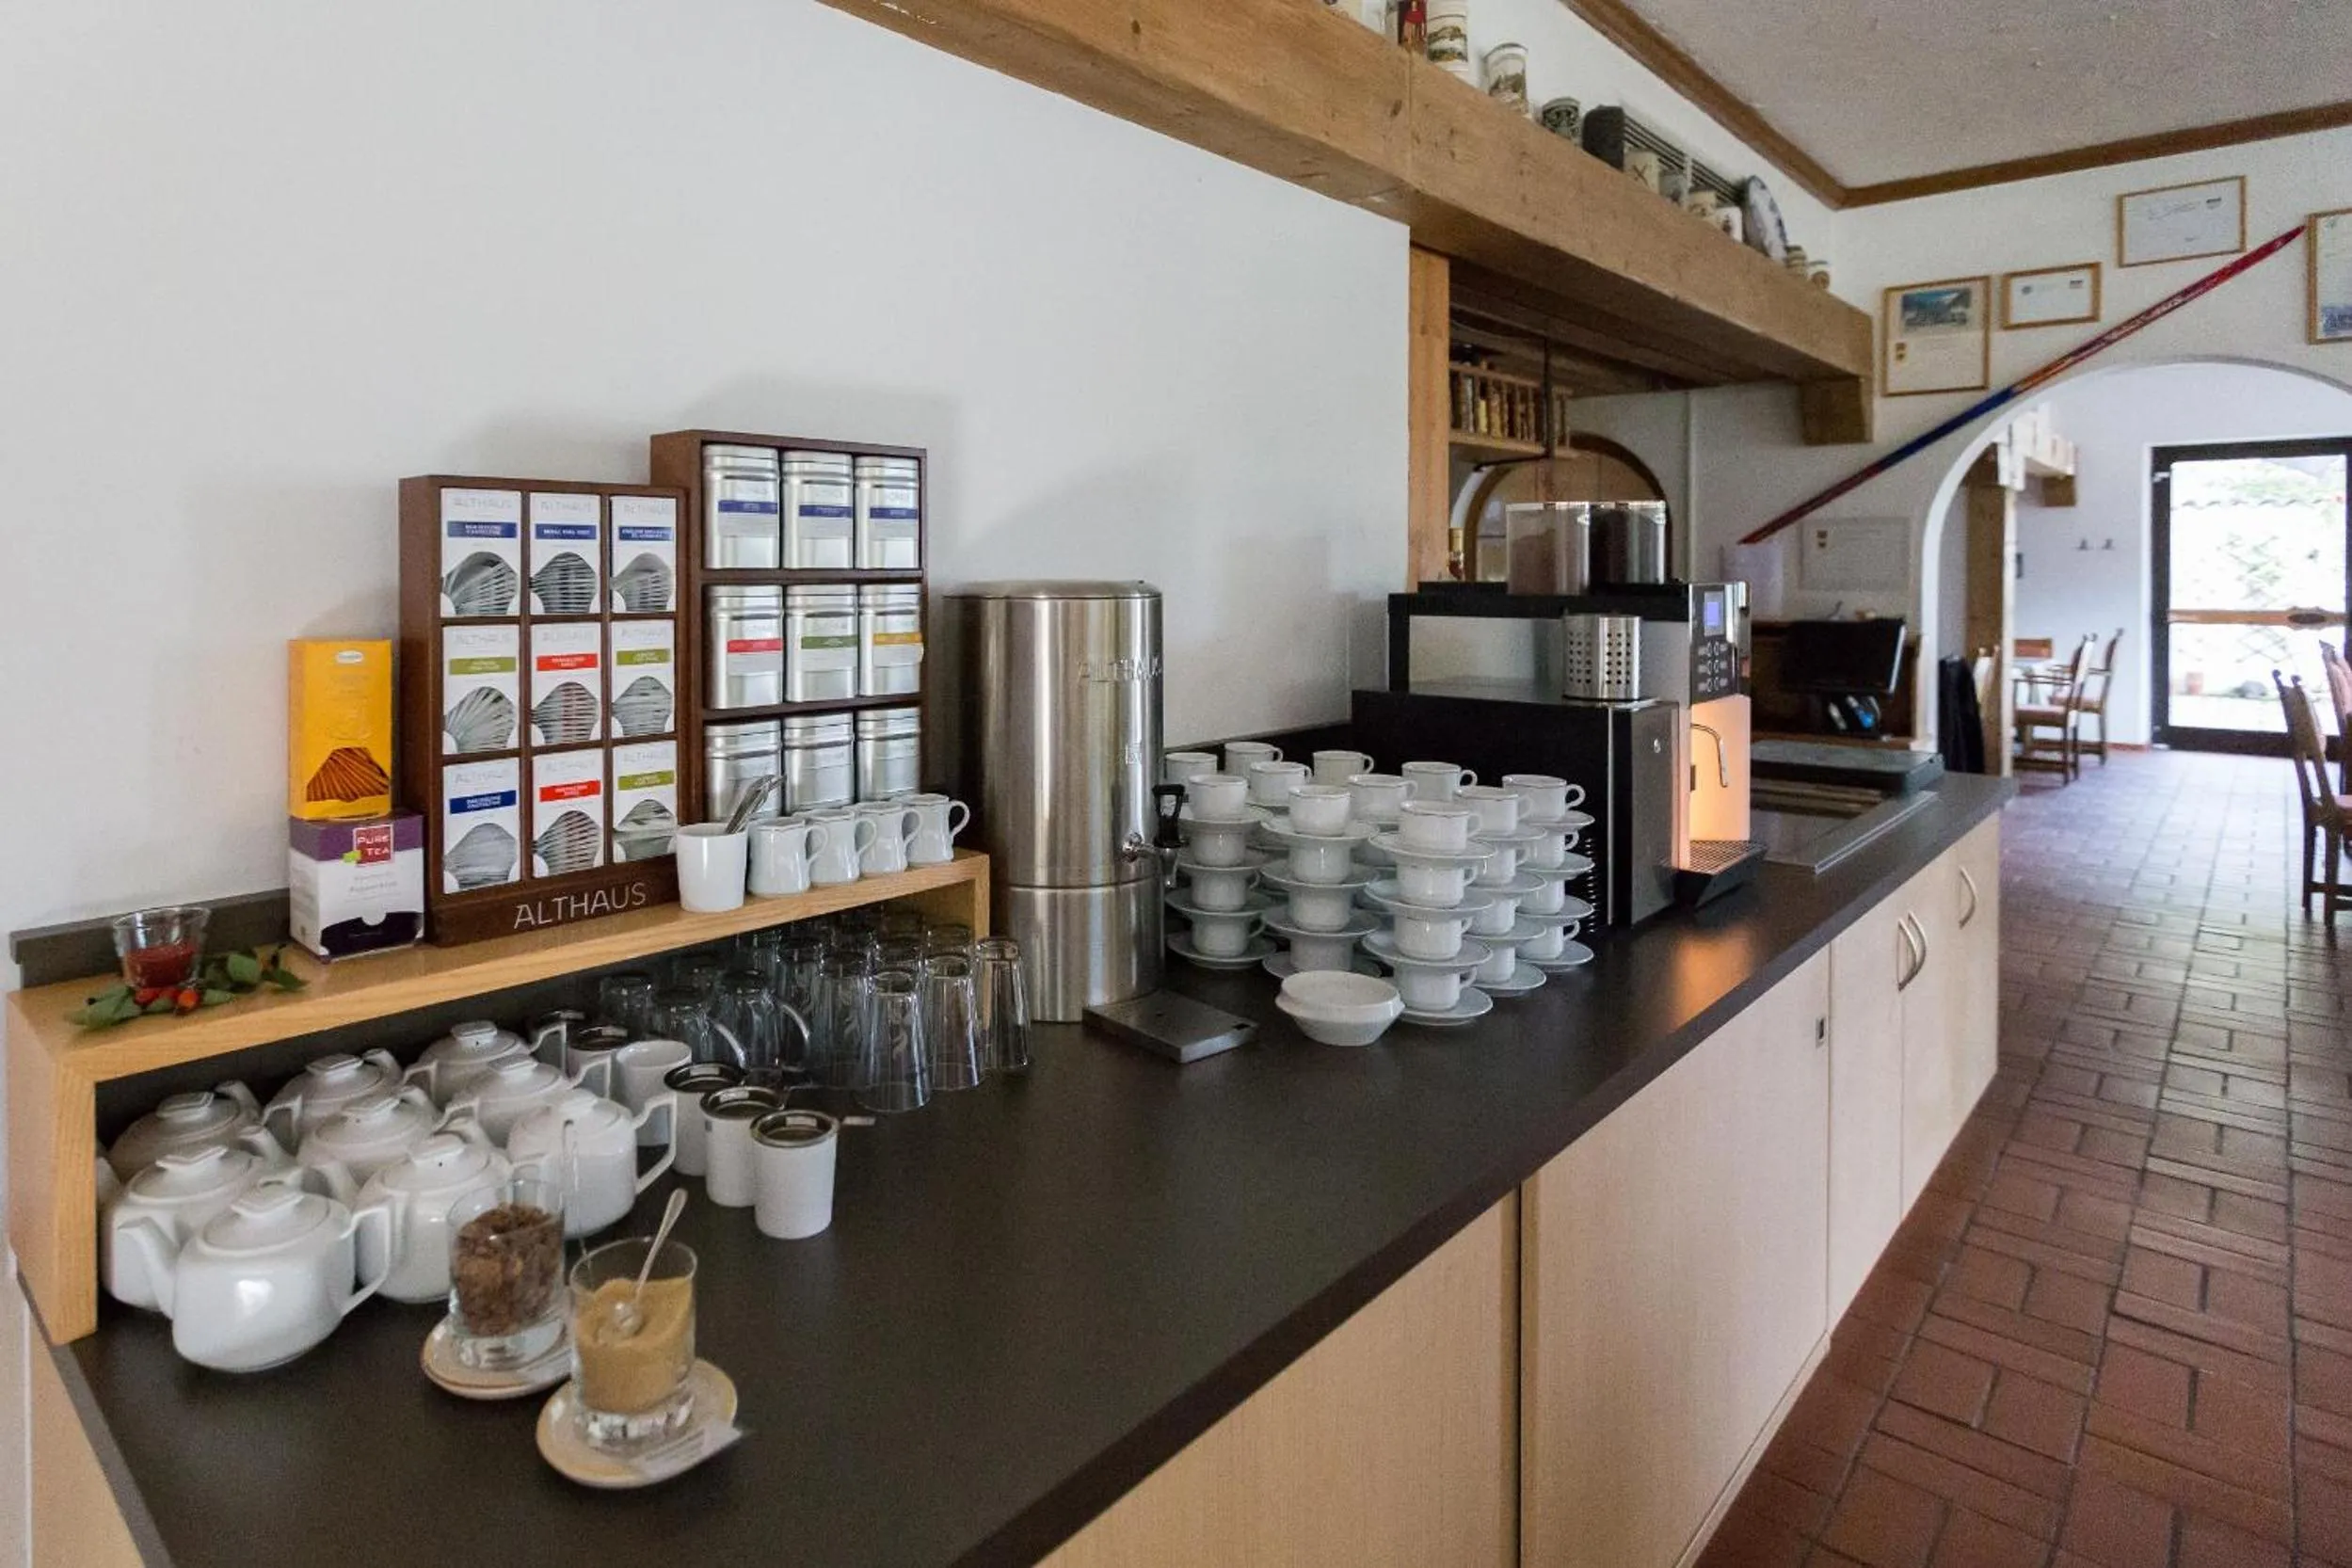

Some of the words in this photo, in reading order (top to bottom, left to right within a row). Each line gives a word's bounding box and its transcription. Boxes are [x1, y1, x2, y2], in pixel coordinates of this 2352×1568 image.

[357, 834, 390, 845] PURE
[364, 847, 390, 856] TEA
[514, 882, 647, 930] ALTHAUS
